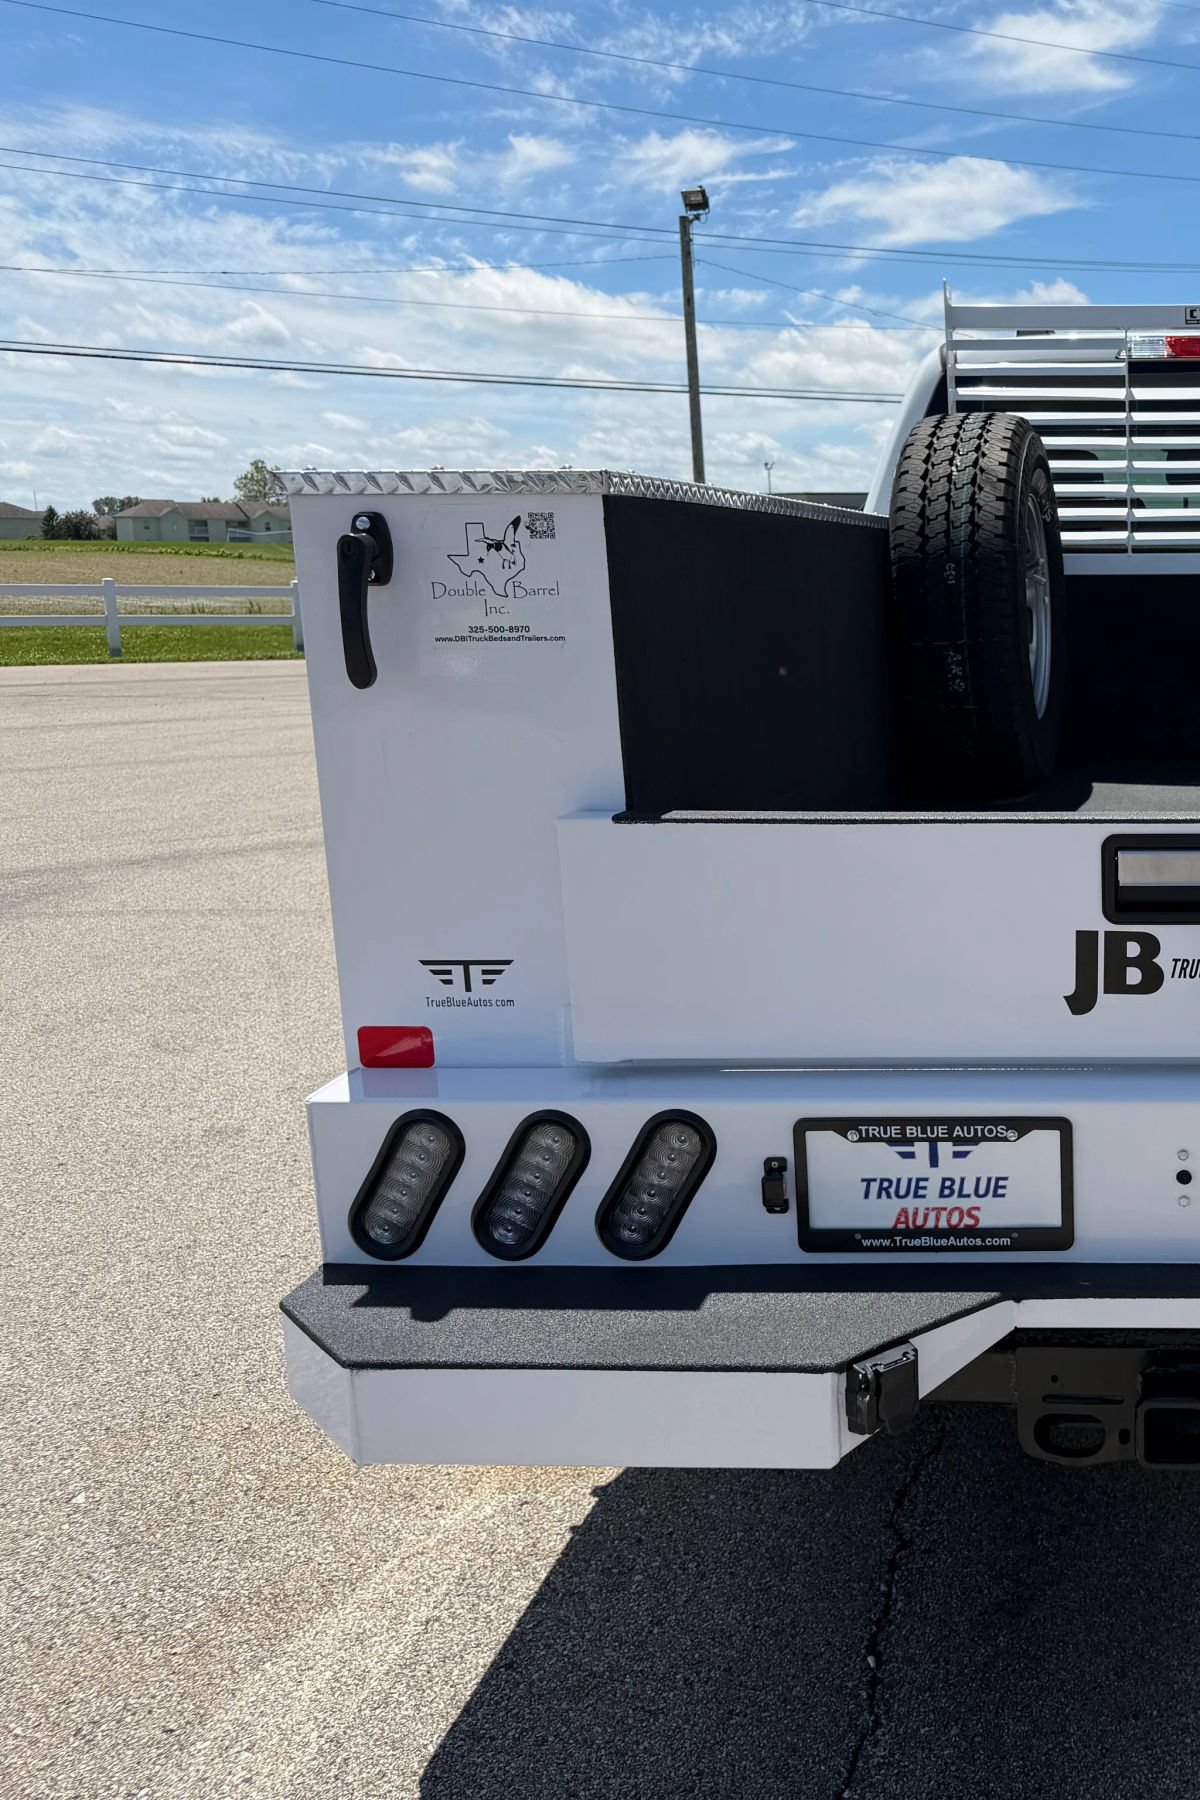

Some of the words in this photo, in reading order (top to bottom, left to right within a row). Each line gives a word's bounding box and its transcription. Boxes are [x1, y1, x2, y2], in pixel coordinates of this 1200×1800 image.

[431, 581, 487, 599] Double
[512, 580, 560, 599] Barrel
[484, 598, 511, 617] Inc.
[468, 625, 531, 634] 325-500-8970
[435, 635, 566, 643] www.DBITruckBedsandTrailers.com
[1063, 929, 1165, 1016] JB
[424, 996, 515, 1008] TrueBlueAutos.com
[858, 1125, 902, 1139] TRUE
[906, 1125, 949, 1138] BLUE
[953, 1125, 1008, 1138] AUTOS
[860, 1176, 930, 1200] TRUE
[938, 1175, 1010, 1199] BLUE
[891, 1205, 982, 1230] AUTOS
[861, 1235, 1011, 1248] www.TrueBlueAutos.com
